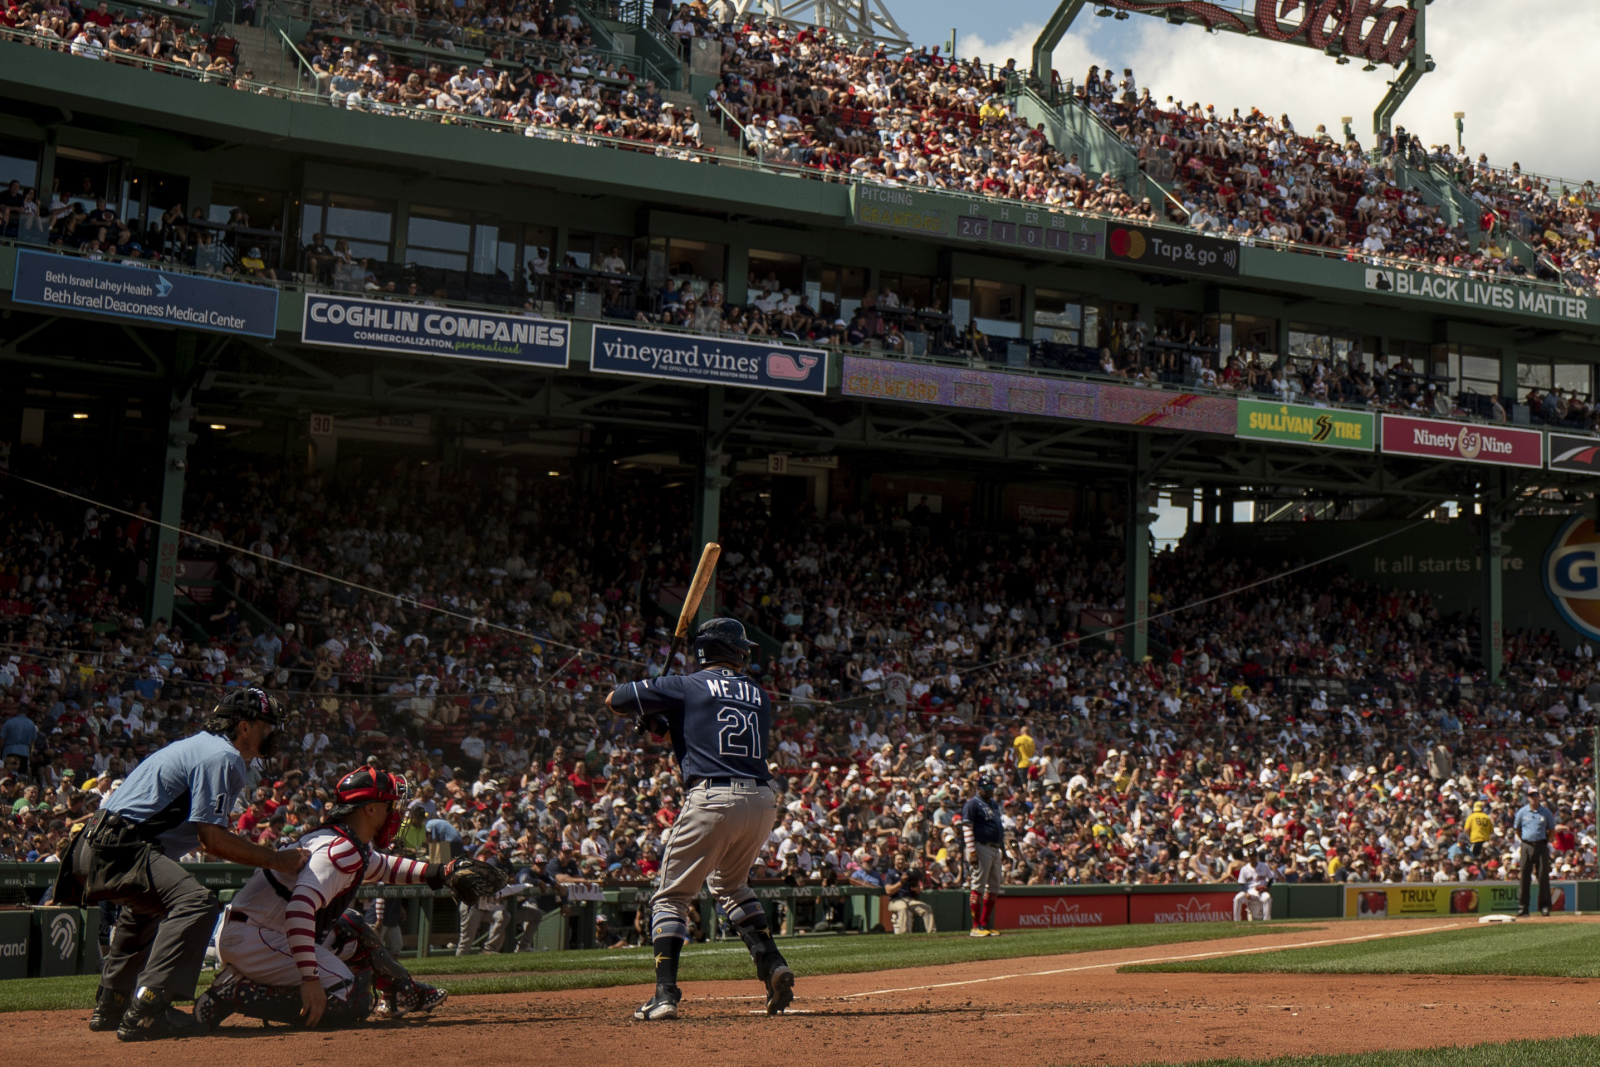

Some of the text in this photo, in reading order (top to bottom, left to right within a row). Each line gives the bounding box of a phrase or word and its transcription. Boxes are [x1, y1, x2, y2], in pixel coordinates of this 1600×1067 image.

[861, 187, 913, 206] PITCHING
[860, 206, 941, 232] CRAWFORD
[969, 204, 1065, 228] IP ER BB
[964, 221, 981, 236] 2.0
[46, 271, 152, 297] Beth Israel Lahey Health
[1396, 272, 1588, 320] BLACK LIVES MATTER
[44, 287, 246, 330] Beth Israel Deaconess Medical Center
[310, 302, 566, 347] COGHLIN COMPANIES
[354, 331, 454, 349] COMMERCIALIZATION.
[603, 337, 759, 373] vineyard vines
[850, 376, 938, 400] CRAWFORD
[314, 417, 330, 433] 30
[1335, 421, 1362, 440] TIRE
[1414, 429, 1457, 451] Ninety
[1482, 437, 1512, 455] Nine
[772, 457, 784, 471] 31
[1374, 556, 1463, 573] It all starts
[718, 706, 762, 759] 21
[1400, 889, 1437, 903] TRULY
[1490, 888, 1520, 901] TRUL
[1018, 912, 1102, 926] KING'S HAWAIIAN
[1154, 911, 1232, 923] KING'S HAWAIIAN
